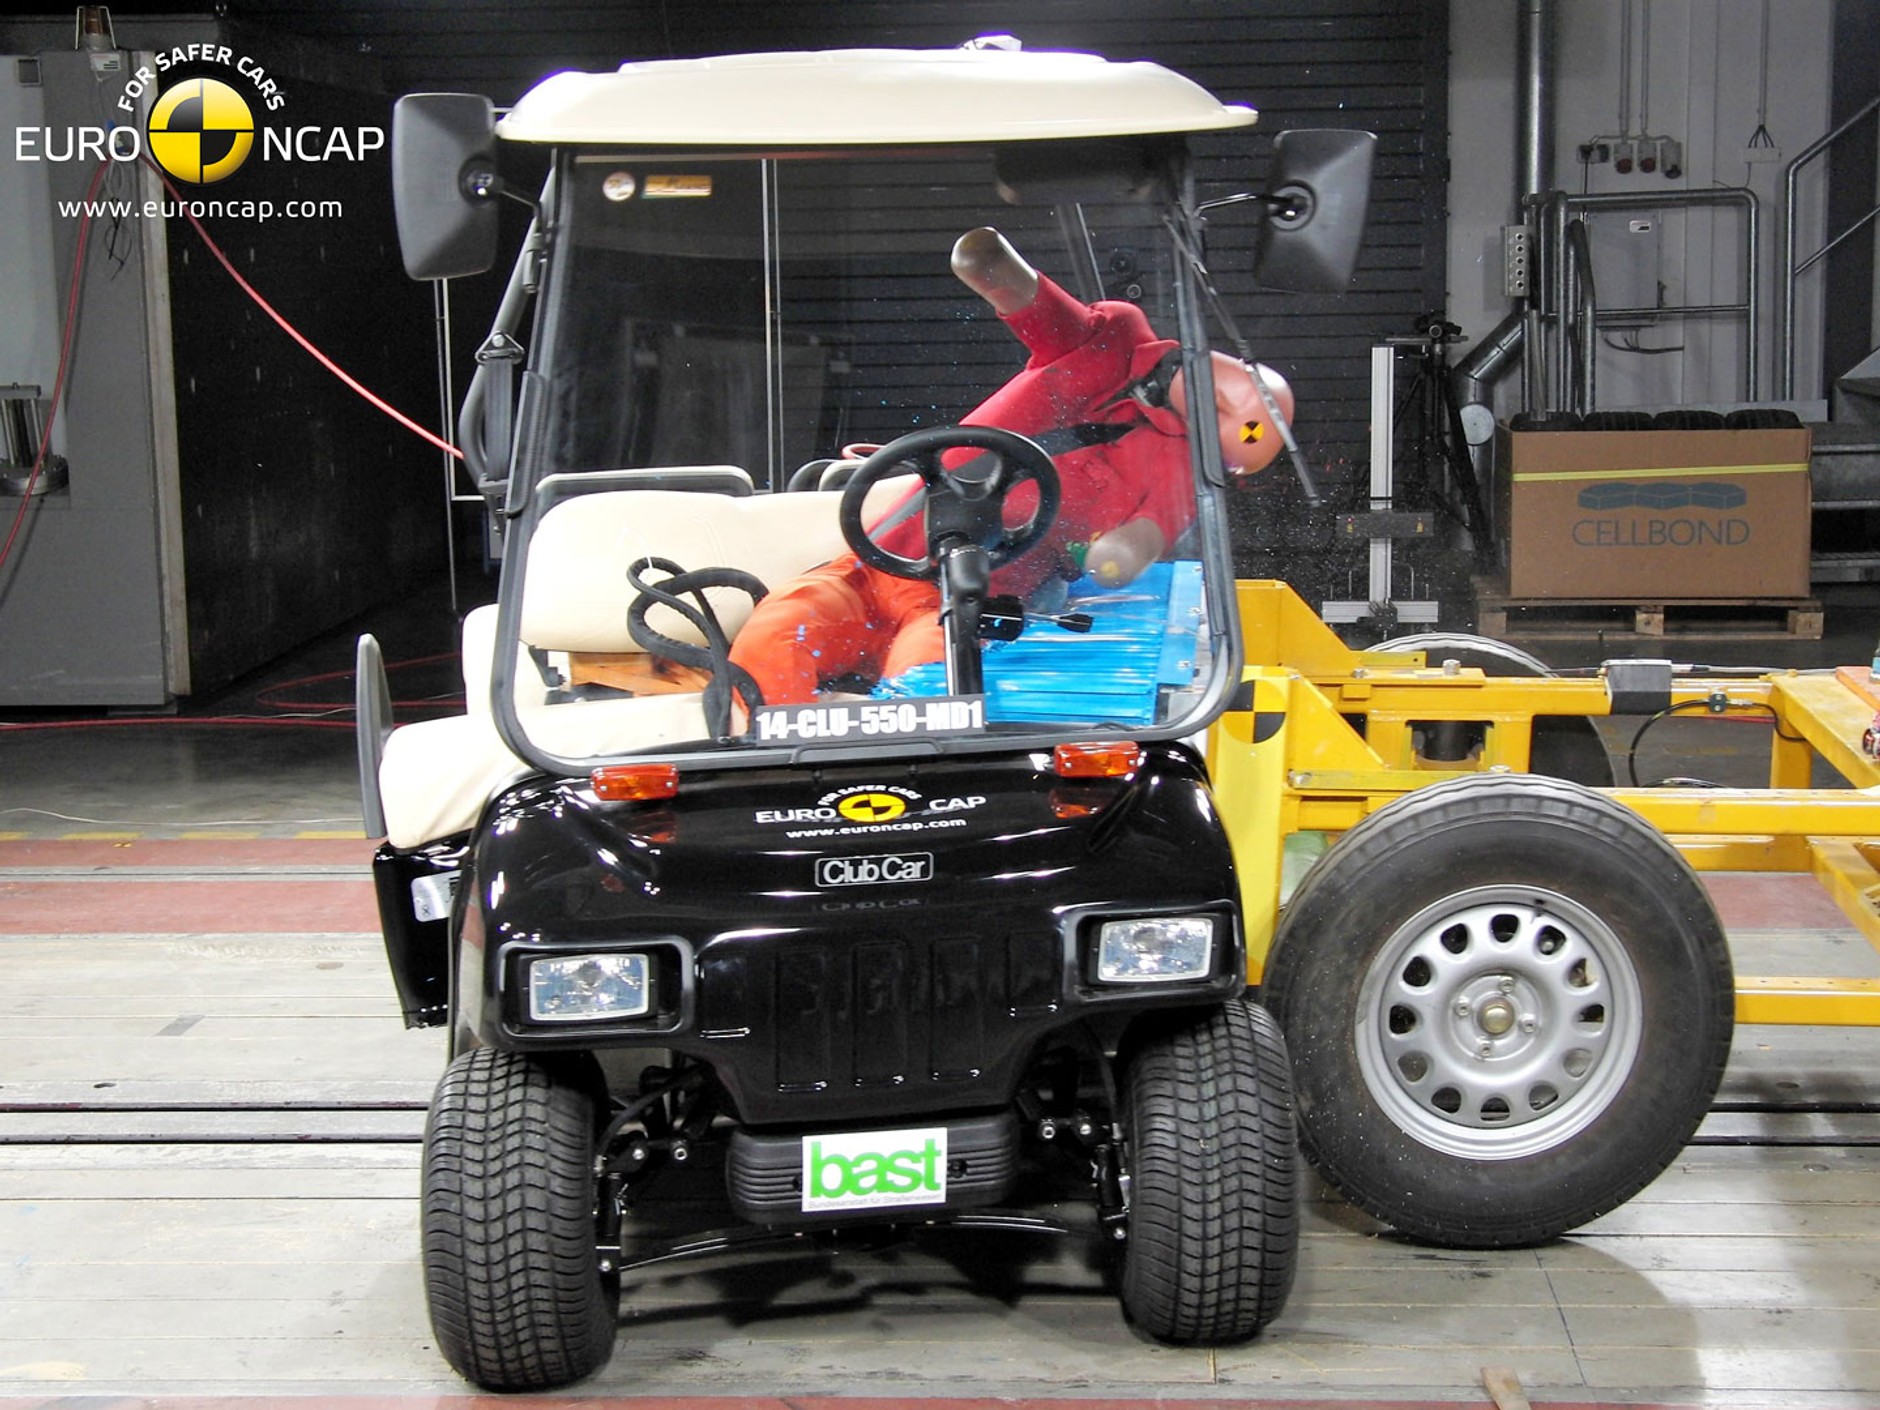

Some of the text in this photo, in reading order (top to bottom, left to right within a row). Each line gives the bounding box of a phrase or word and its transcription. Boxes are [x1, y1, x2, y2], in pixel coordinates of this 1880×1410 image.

[1572, 519, 1750, 546] CELLBOND
[757, 700, 983, 740] 14-CLU-550-MD1
[838, 785, 887, 795] SAFER
[756, 808, 837, 823] EURO
[786, 817, 967, 838] www.euroncap.com
[810, 1139, 941, 1198] bast
